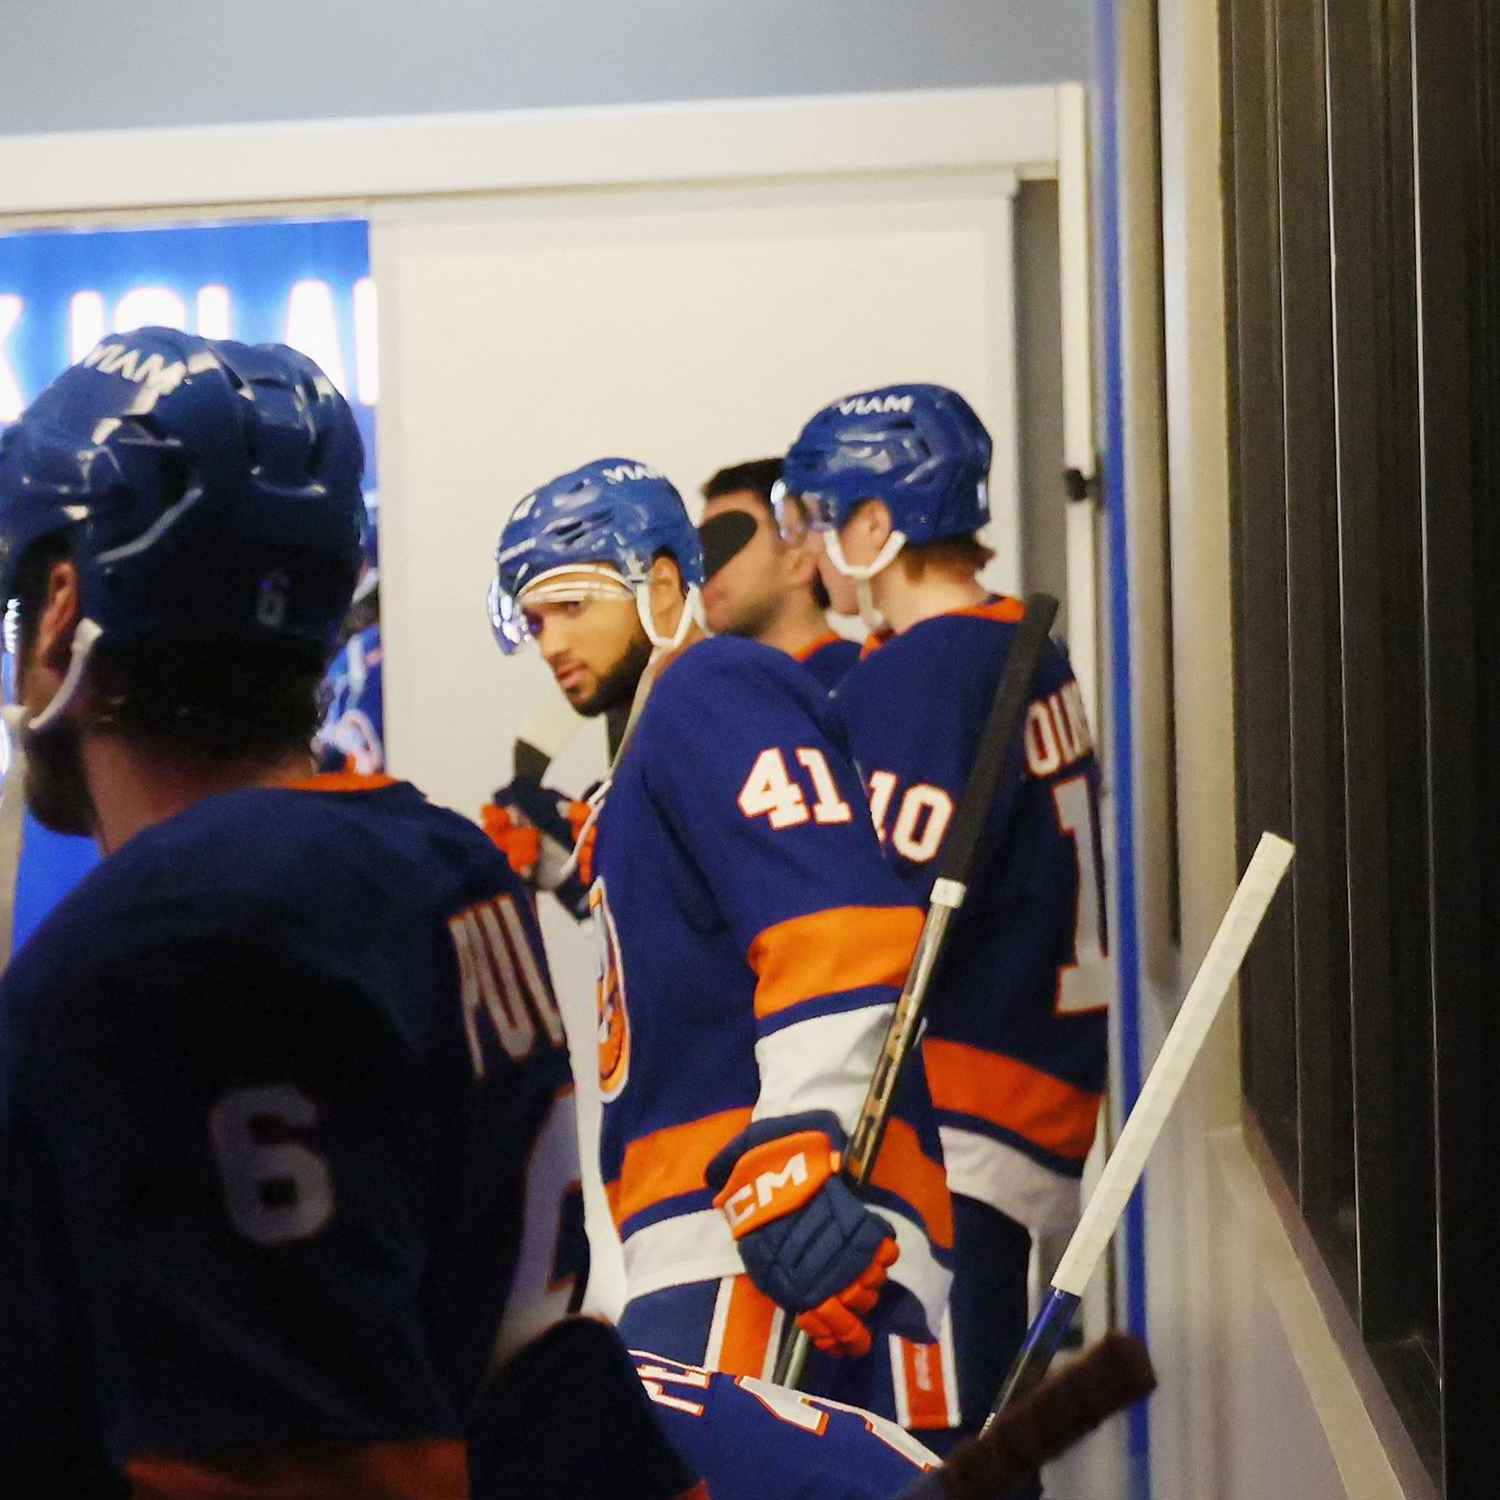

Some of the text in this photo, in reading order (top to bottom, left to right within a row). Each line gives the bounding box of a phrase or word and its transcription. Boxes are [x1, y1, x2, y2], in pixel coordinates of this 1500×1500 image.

[839, 395, 914, 415] VIAM
[736, 746, 852, 831] 41
[869, 769, 954, 864] 10
[447, 894, 566, 1080] PUL
[211, 1083, 336, 1246] 6
[728, 1151, 810, 1228] CM
